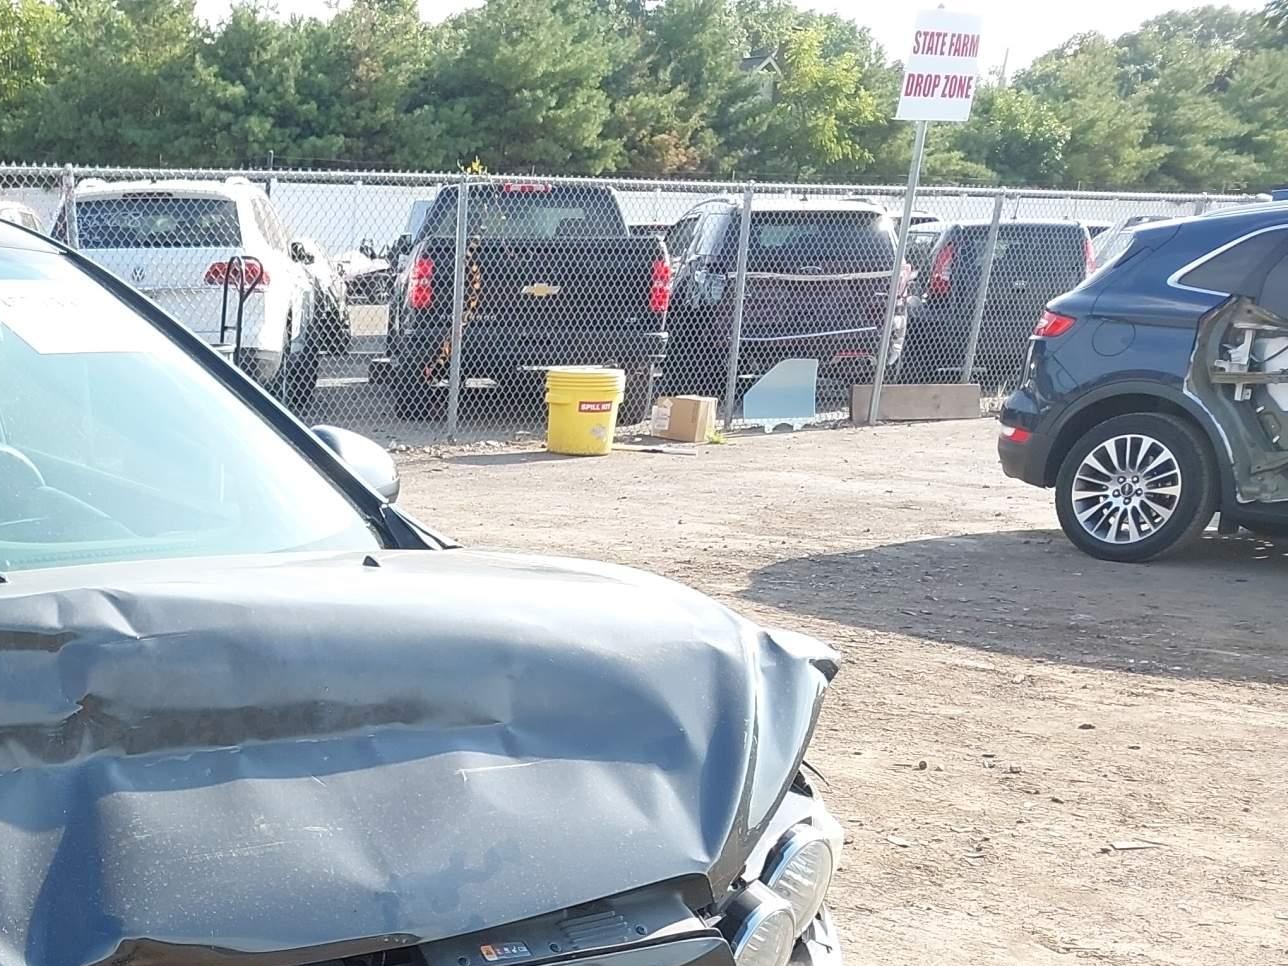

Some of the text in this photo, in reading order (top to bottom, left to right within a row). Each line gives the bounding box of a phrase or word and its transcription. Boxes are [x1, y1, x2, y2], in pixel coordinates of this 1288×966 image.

[913, 30, 980, 57] STATE FARM
[904, 73, 974, 99] DROP ZONE
[580, 403, 600, 411] SPILL
